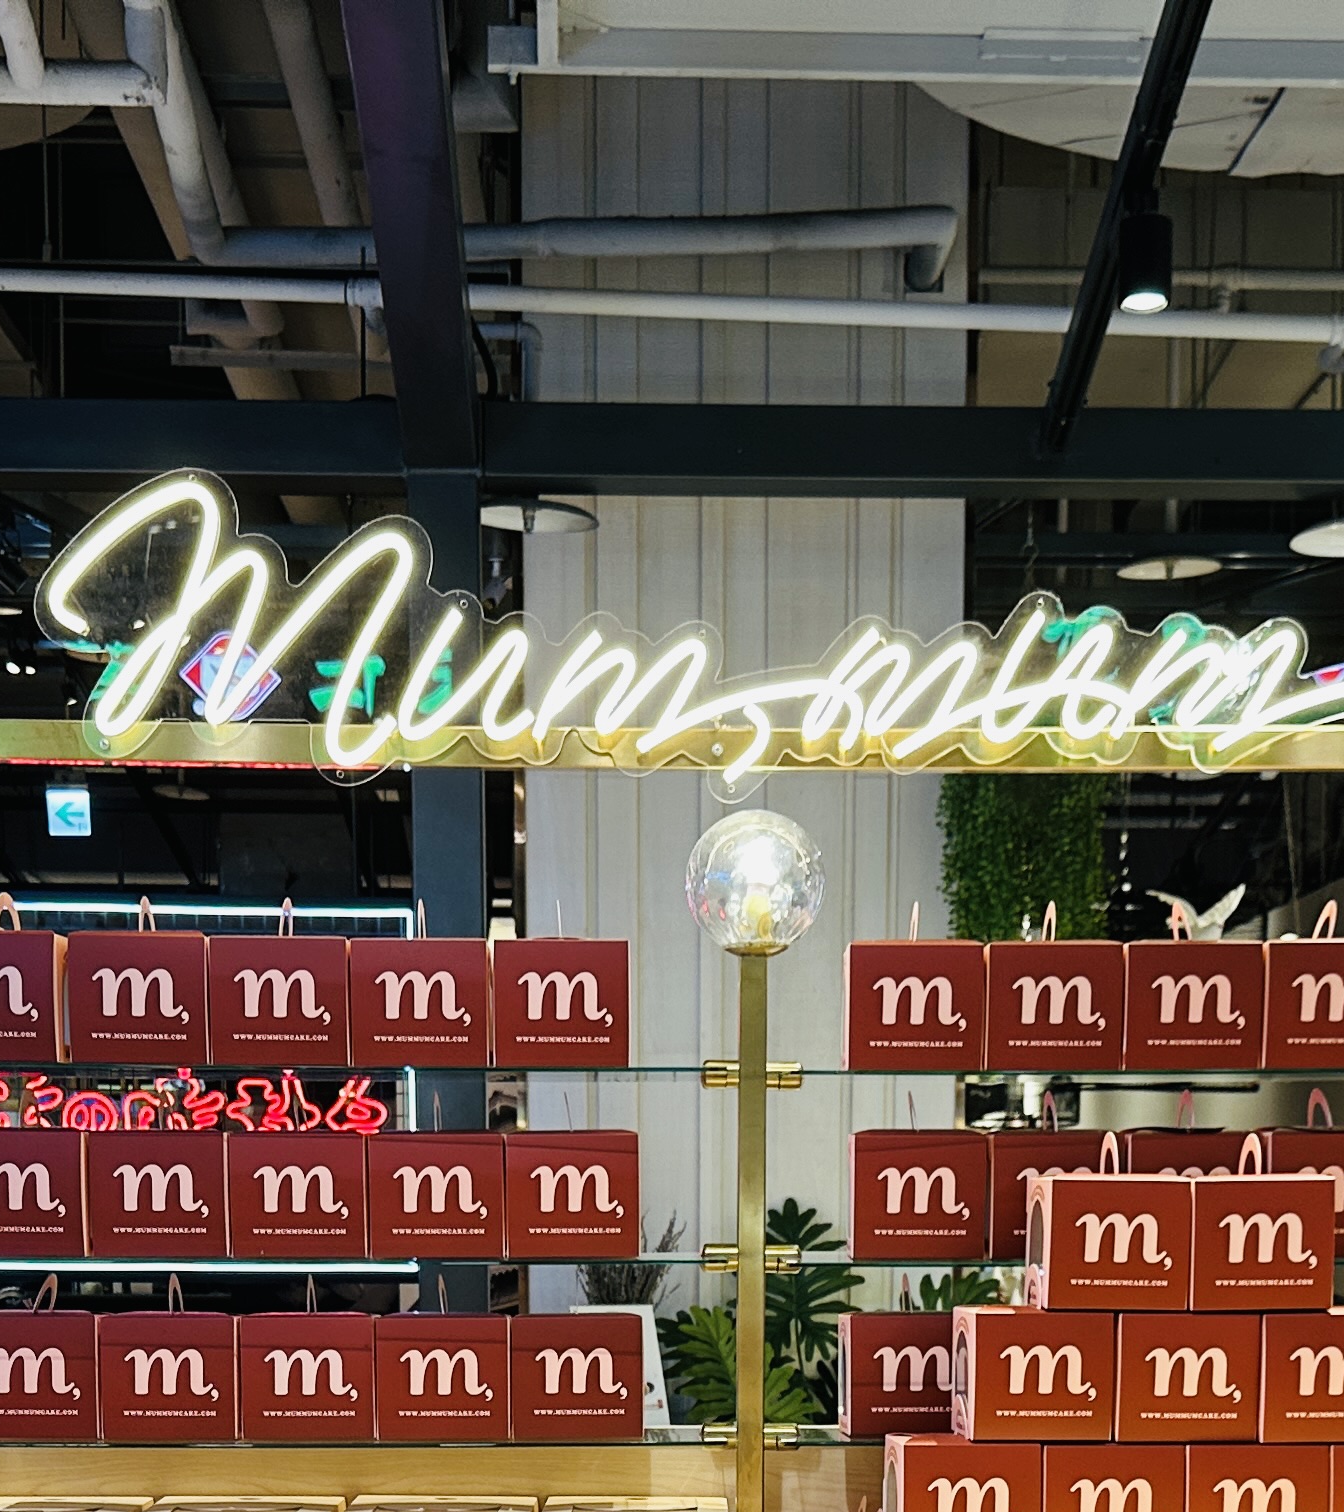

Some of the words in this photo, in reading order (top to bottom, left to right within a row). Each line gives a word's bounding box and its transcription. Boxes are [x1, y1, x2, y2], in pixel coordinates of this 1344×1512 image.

[91, 967, 190, 1025] m,
[233, 968, 331, 1026] m,
[374, 970, 472, 1027] m,
[517, 971, 614, 1028] m,
[872, 976, 967, 1032] m,
[1011, 975, 1106, 1032] m,
[1151, 974, 1246, 1030] m,
[112, 1163, 210, 1219] m,
[253, 1165, 349, 1220] m,
[392, 1165, 488, 1220] m,
[530, 1164, 625, 1219] m,
[877, 1166, 970, 1221] m,
[1075, 1212, 1173, 1271] m,
[1218, 1212, 1318, 1270] m,
[123, 1348, 219, 1402] m,
[263, 1349, 359, 1402] m,
[399, 1348, 494, 1402] m,
[534, 1347, 628, 1400] m,
[999, 1344, 1097, 1402] m,
[1144, 1347, 1242, 1404] m,
